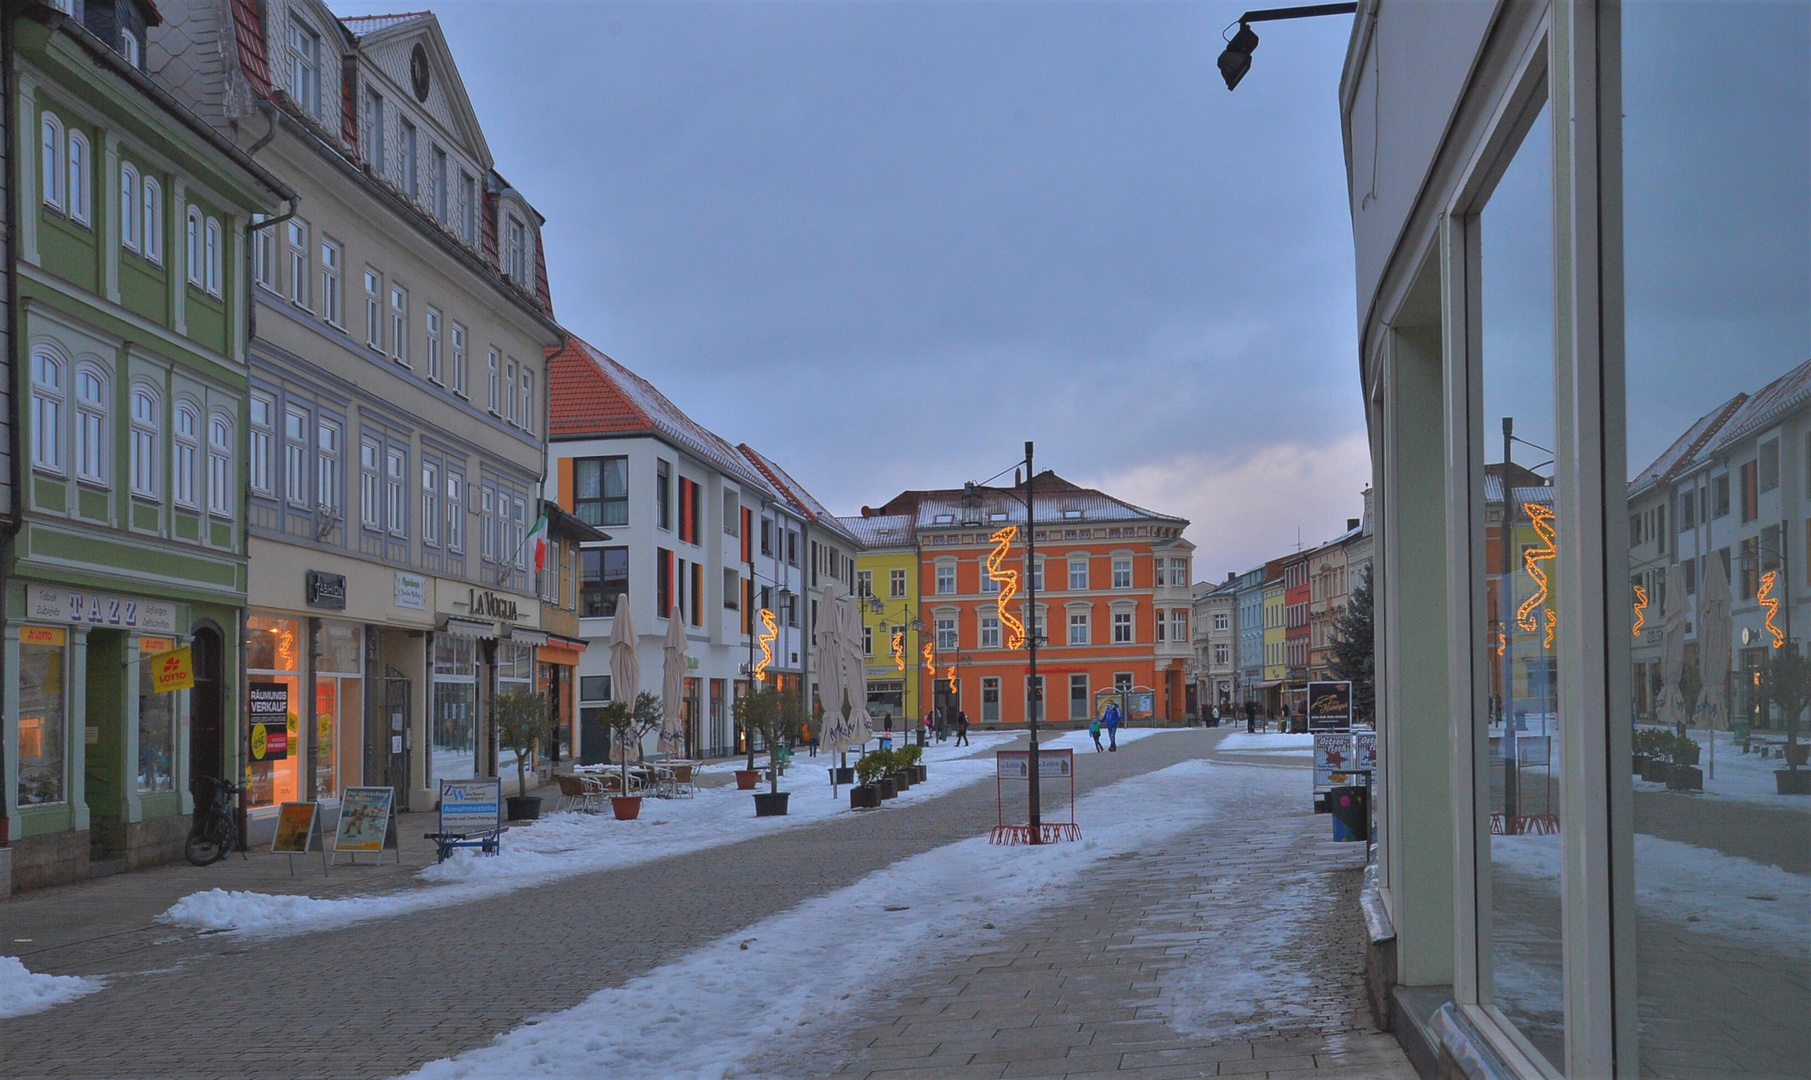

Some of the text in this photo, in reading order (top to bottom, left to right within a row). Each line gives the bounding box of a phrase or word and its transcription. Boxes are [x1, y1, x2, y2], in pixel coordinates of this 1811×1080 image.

[39, 590, 57, 602] Tabak
[36, 604, 60, 616] Zubehör
[68, 592, 137, 626] TAZZ
[145, 604, 167, 616] Zeitungen
[142, 617, 170, 629] Zeitschriften
[35, 629, 53, 641] LOTTO
[150, 640, 164, 650] LOTTO
[159, 671, 187, 683] LOTTO
[250, 689, 287, 700] RÄUMUNGS
[250, 701, 287, 712] VERKAUF
